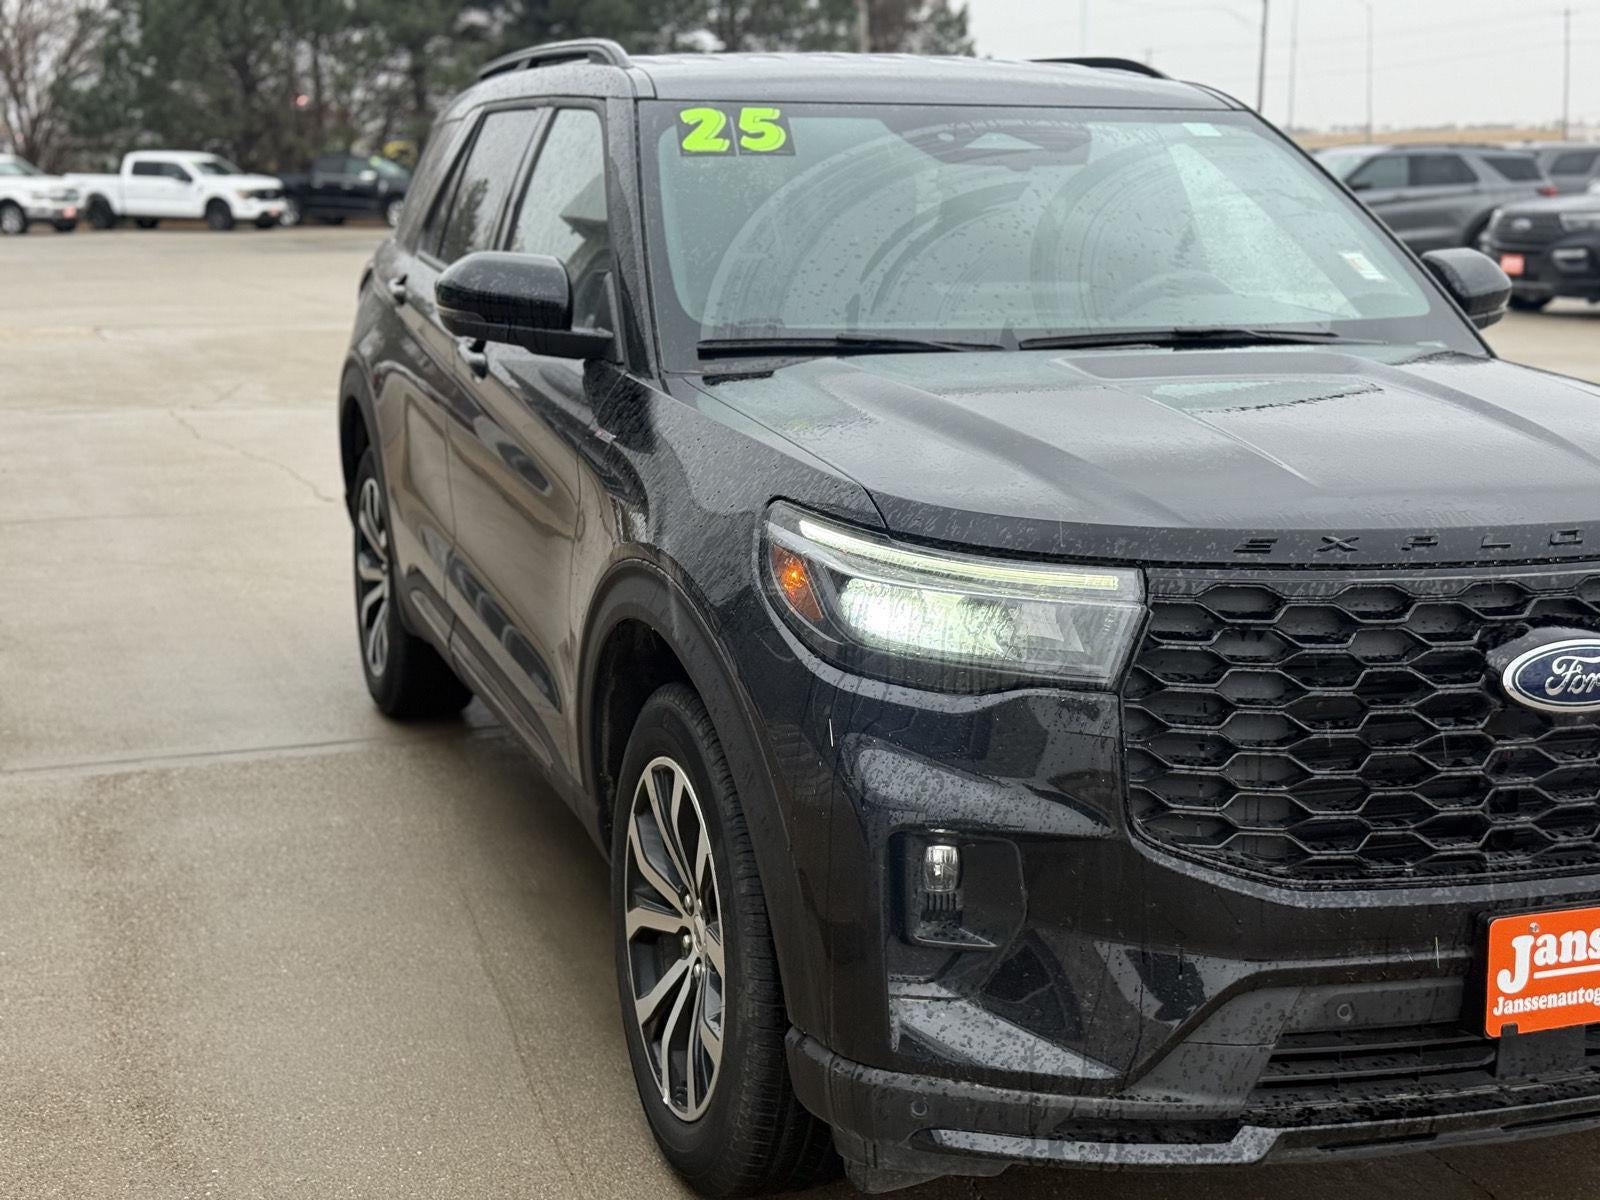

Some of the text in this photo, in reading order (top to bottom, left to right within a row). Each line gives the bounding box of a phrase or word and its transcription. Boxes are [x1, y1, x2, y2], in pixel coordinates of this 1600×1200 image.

[680, 107, 786, 152] 25
[1233, 529, 1584, 553] EXPLO
[1545, 656, 1600, 696] For
